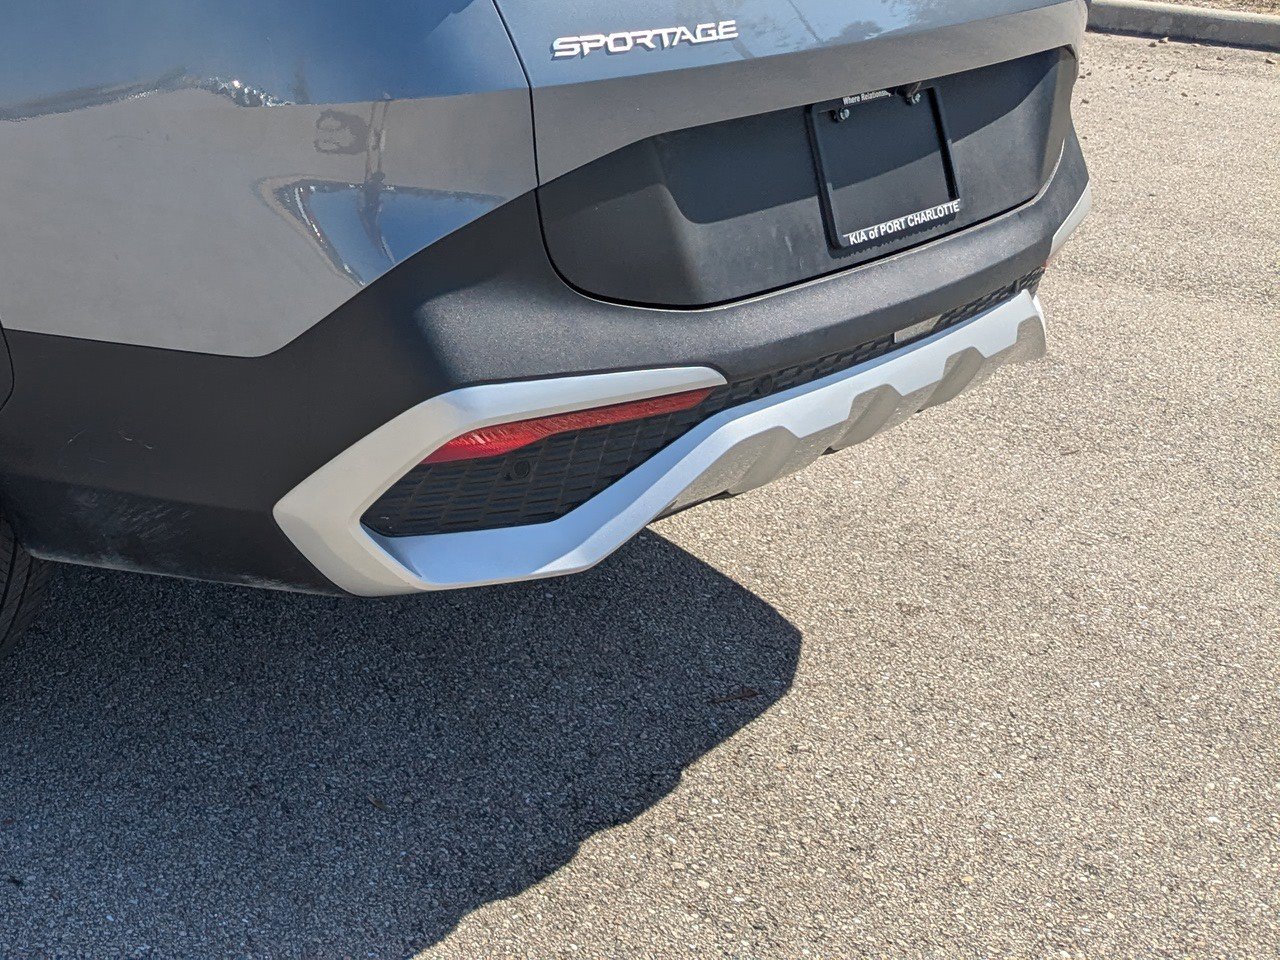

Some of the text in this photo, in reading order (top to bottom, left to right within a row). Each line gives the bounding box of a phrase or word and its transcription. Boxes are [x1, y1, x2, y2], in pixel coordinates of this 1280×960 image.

[552, 19, 739, 59] SPORTAGE
[848, 200, 961, 246] KIA of PORT CHARLOTTE
